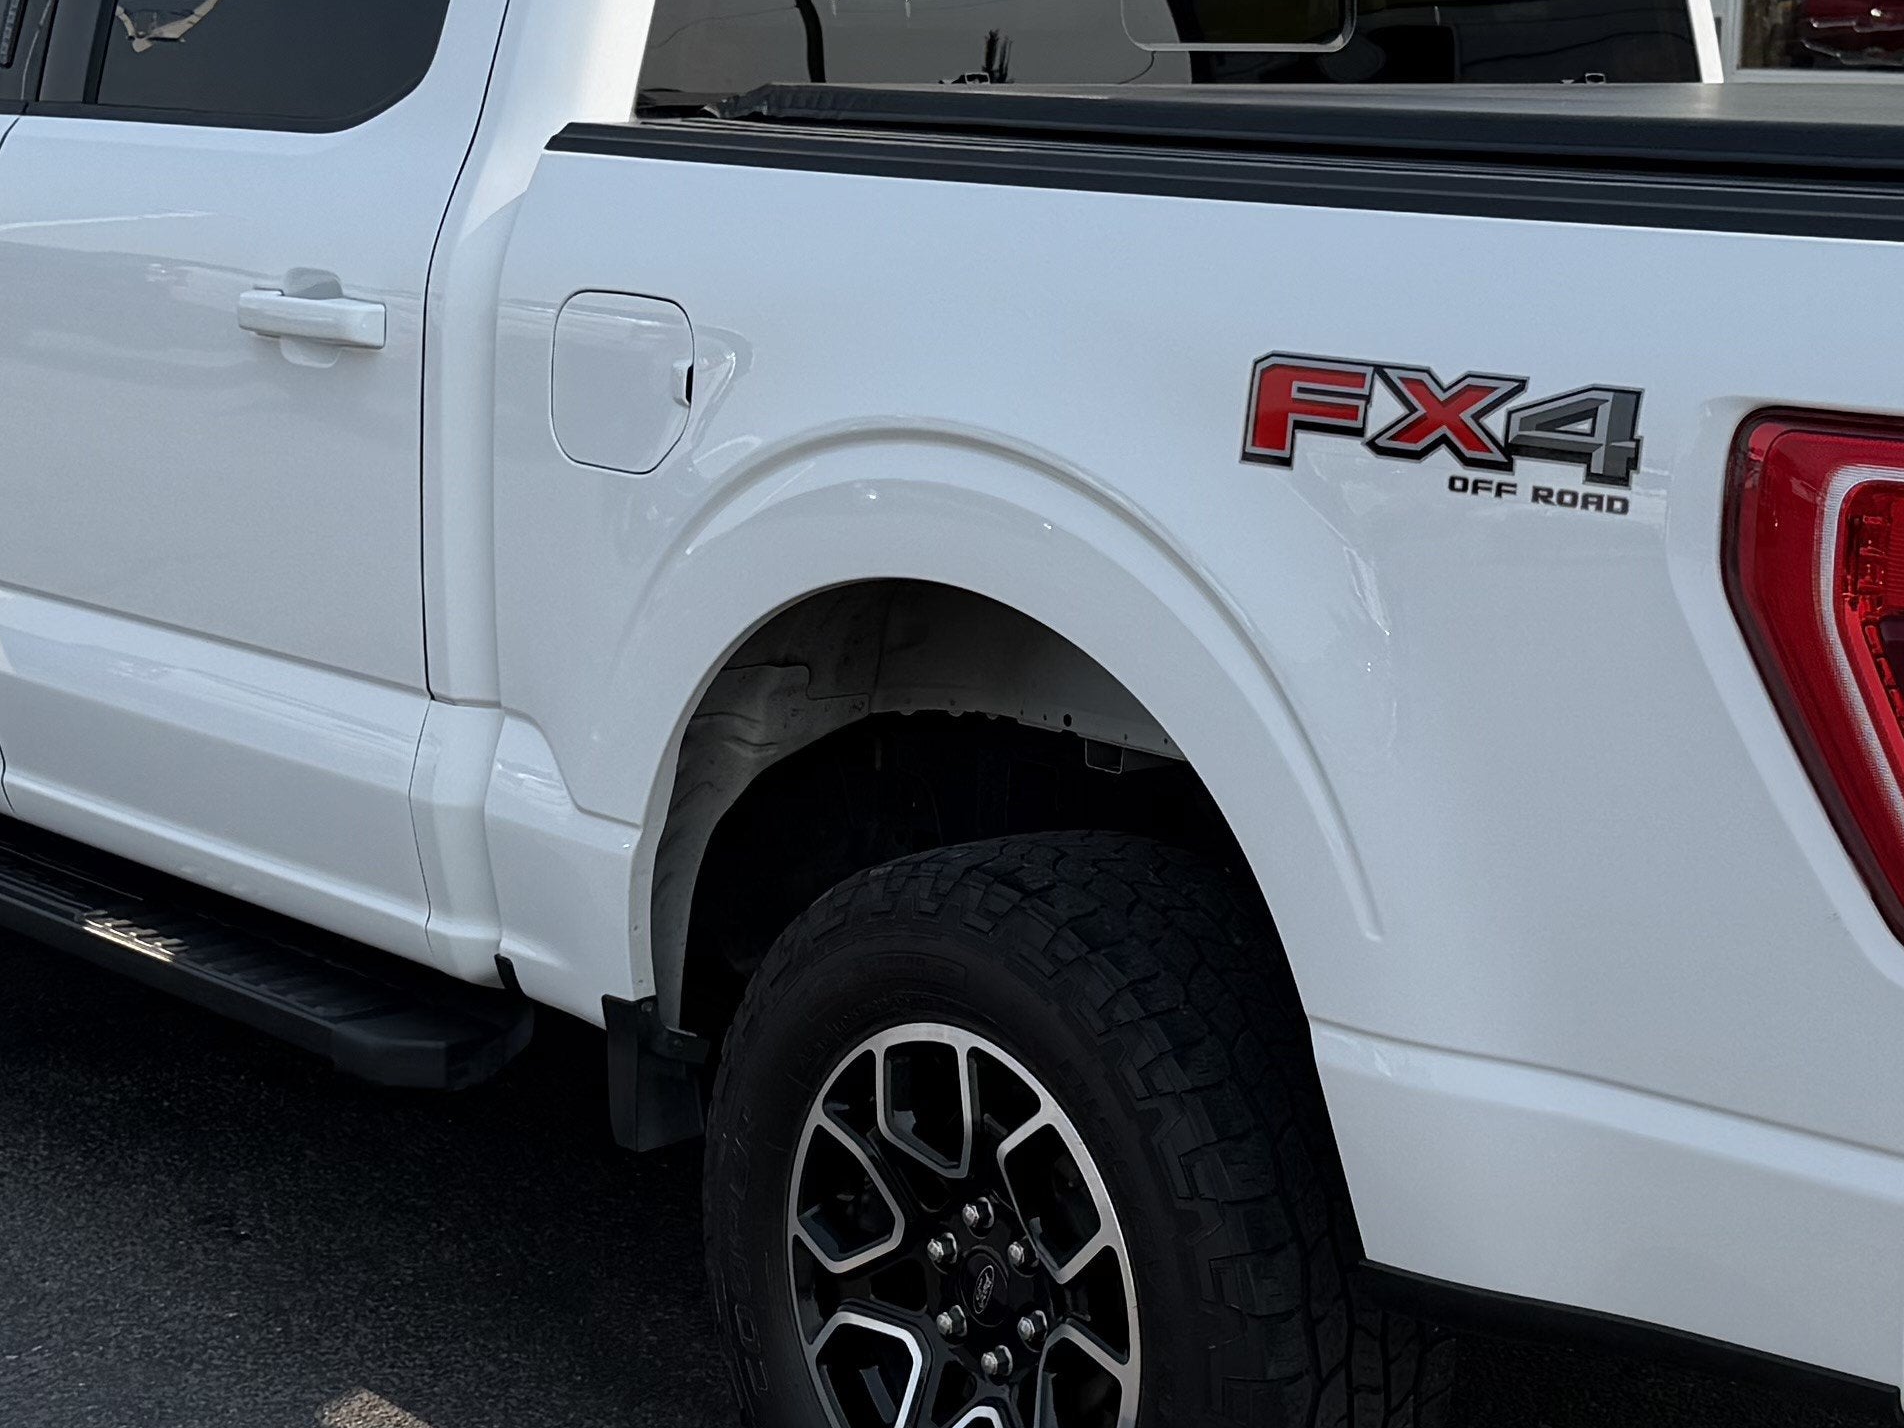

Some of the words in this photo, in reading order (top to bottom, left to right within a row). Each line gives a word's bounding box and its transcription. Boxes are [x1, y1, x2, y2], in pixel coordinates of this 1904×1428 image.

[1239, 350, 1645, 490] FX4
[1447, 474, 1518, 499] OFF
[1530, 484, 1630, 516] ROAD
